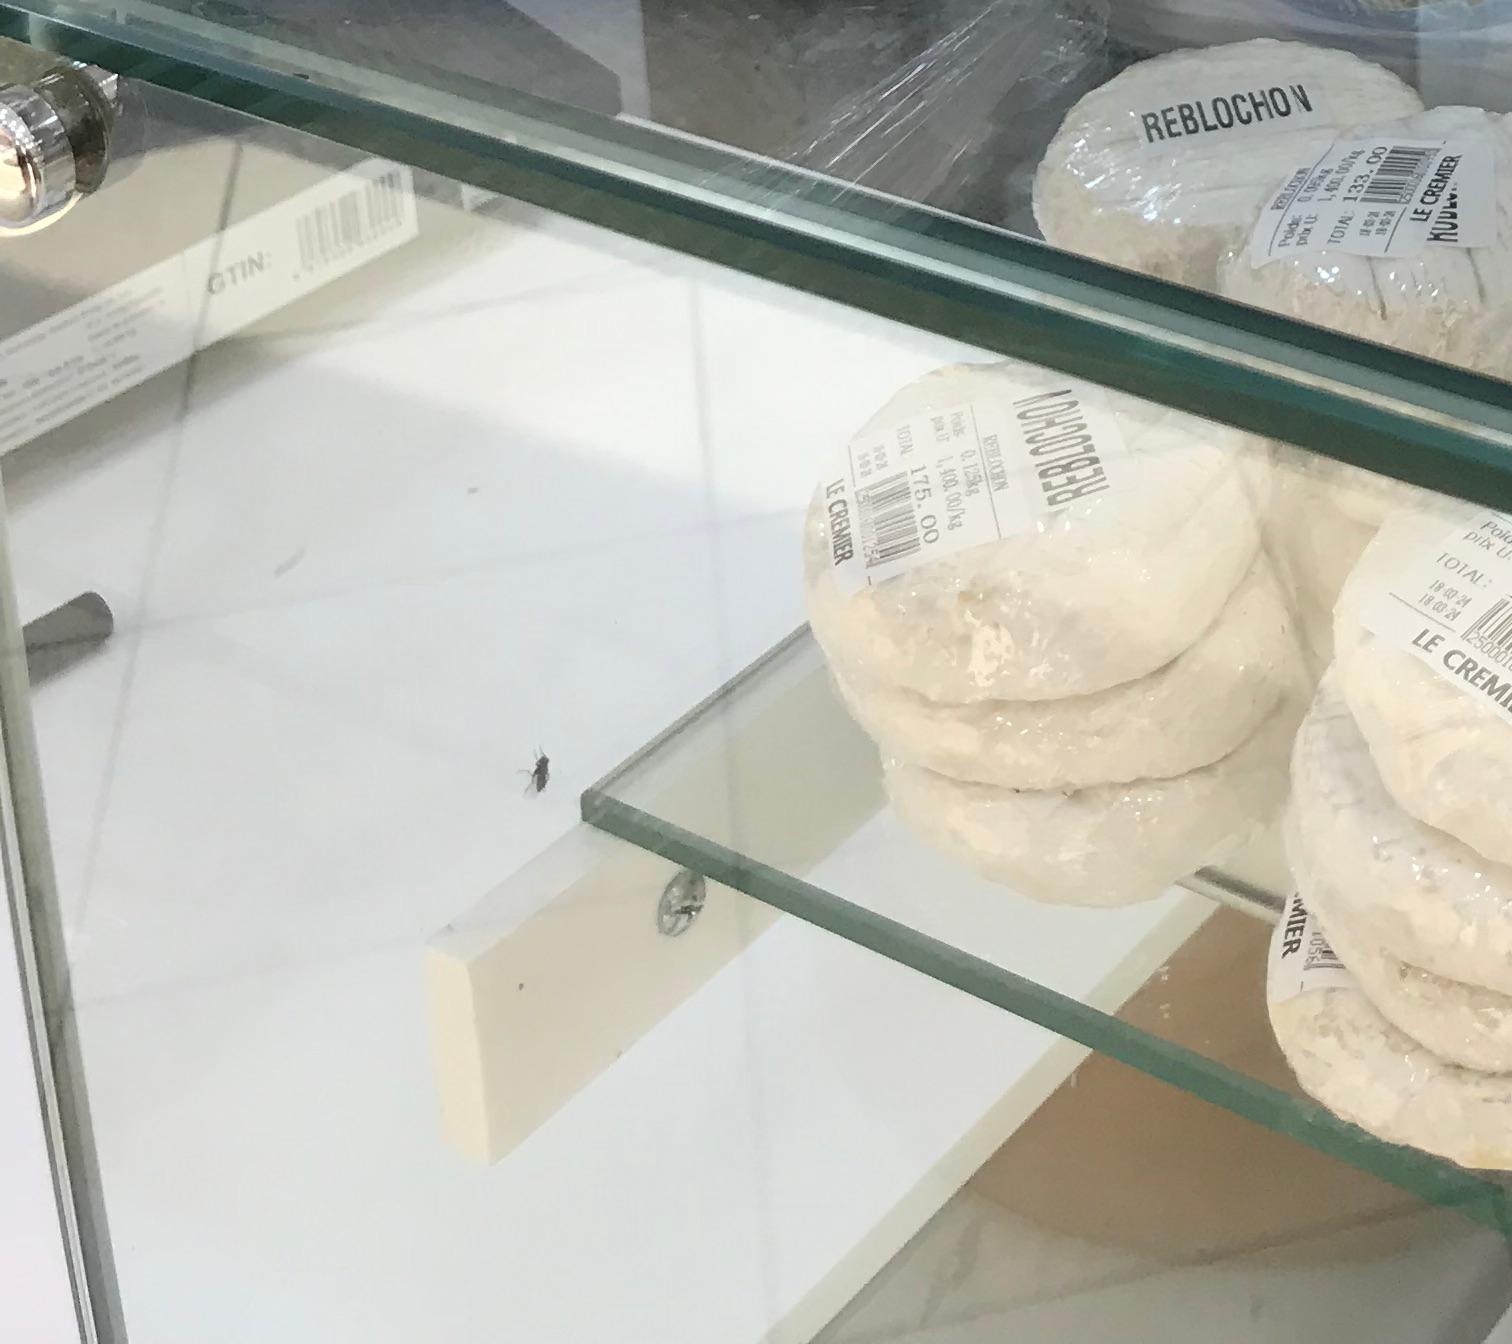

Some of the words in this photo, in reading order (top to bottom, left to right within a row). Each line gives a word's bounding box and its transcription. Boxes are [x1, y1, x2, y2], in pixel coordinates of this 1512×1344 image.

[1140, 83, 1314, 144] REBLOCHON
[1420, 154, 1462, 206] CREMIER
[1410, 208, 1433, 223] LE
[825, 478, 845, 499] LE
[828, 498, 854, 567] CREMIER
[1412, 629, 1445, 653] LE
